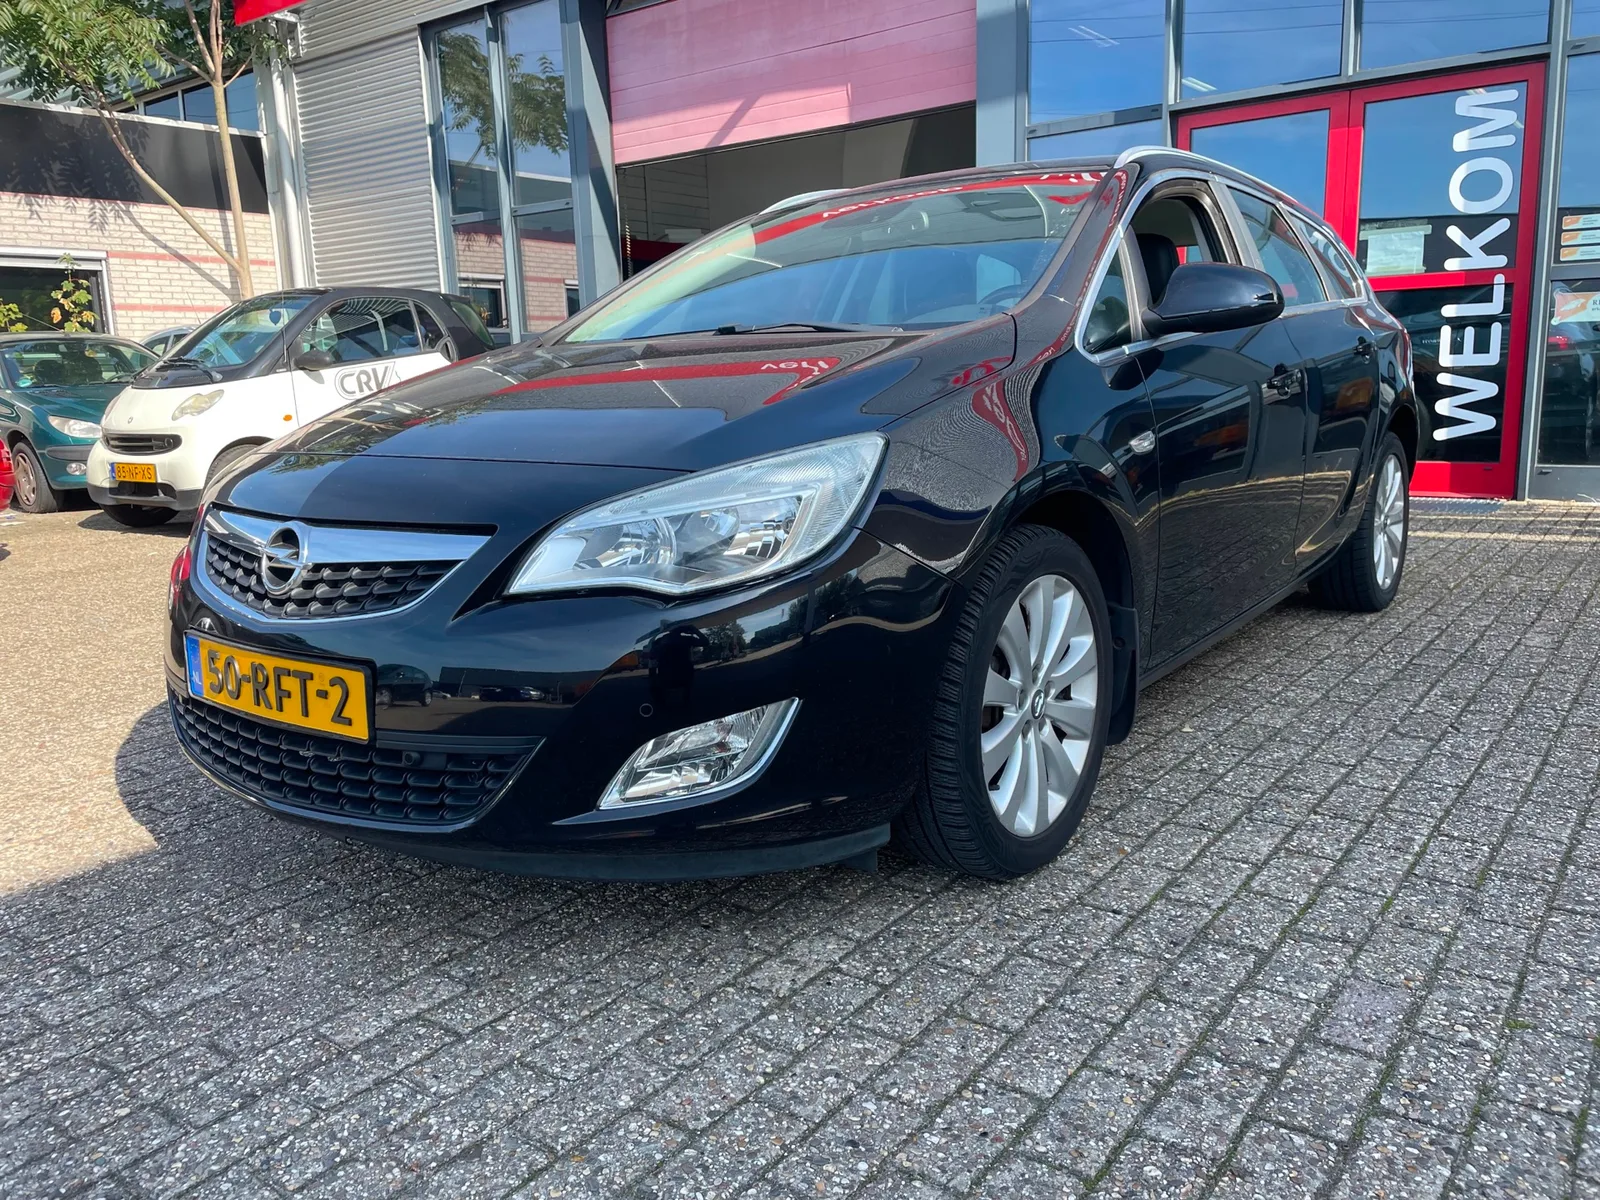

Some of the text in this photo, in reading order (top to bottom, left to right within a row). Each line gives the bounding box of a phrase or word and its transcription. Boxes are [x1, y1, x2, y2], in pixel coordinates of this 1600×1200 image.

[1433, 89, 1519, 441] WELKOM
[340, 365, 389, 395] CRV
[116, 465, 153, 480] 85-NF-XS
[207, 648, 353, 727] 50-RFT-2
